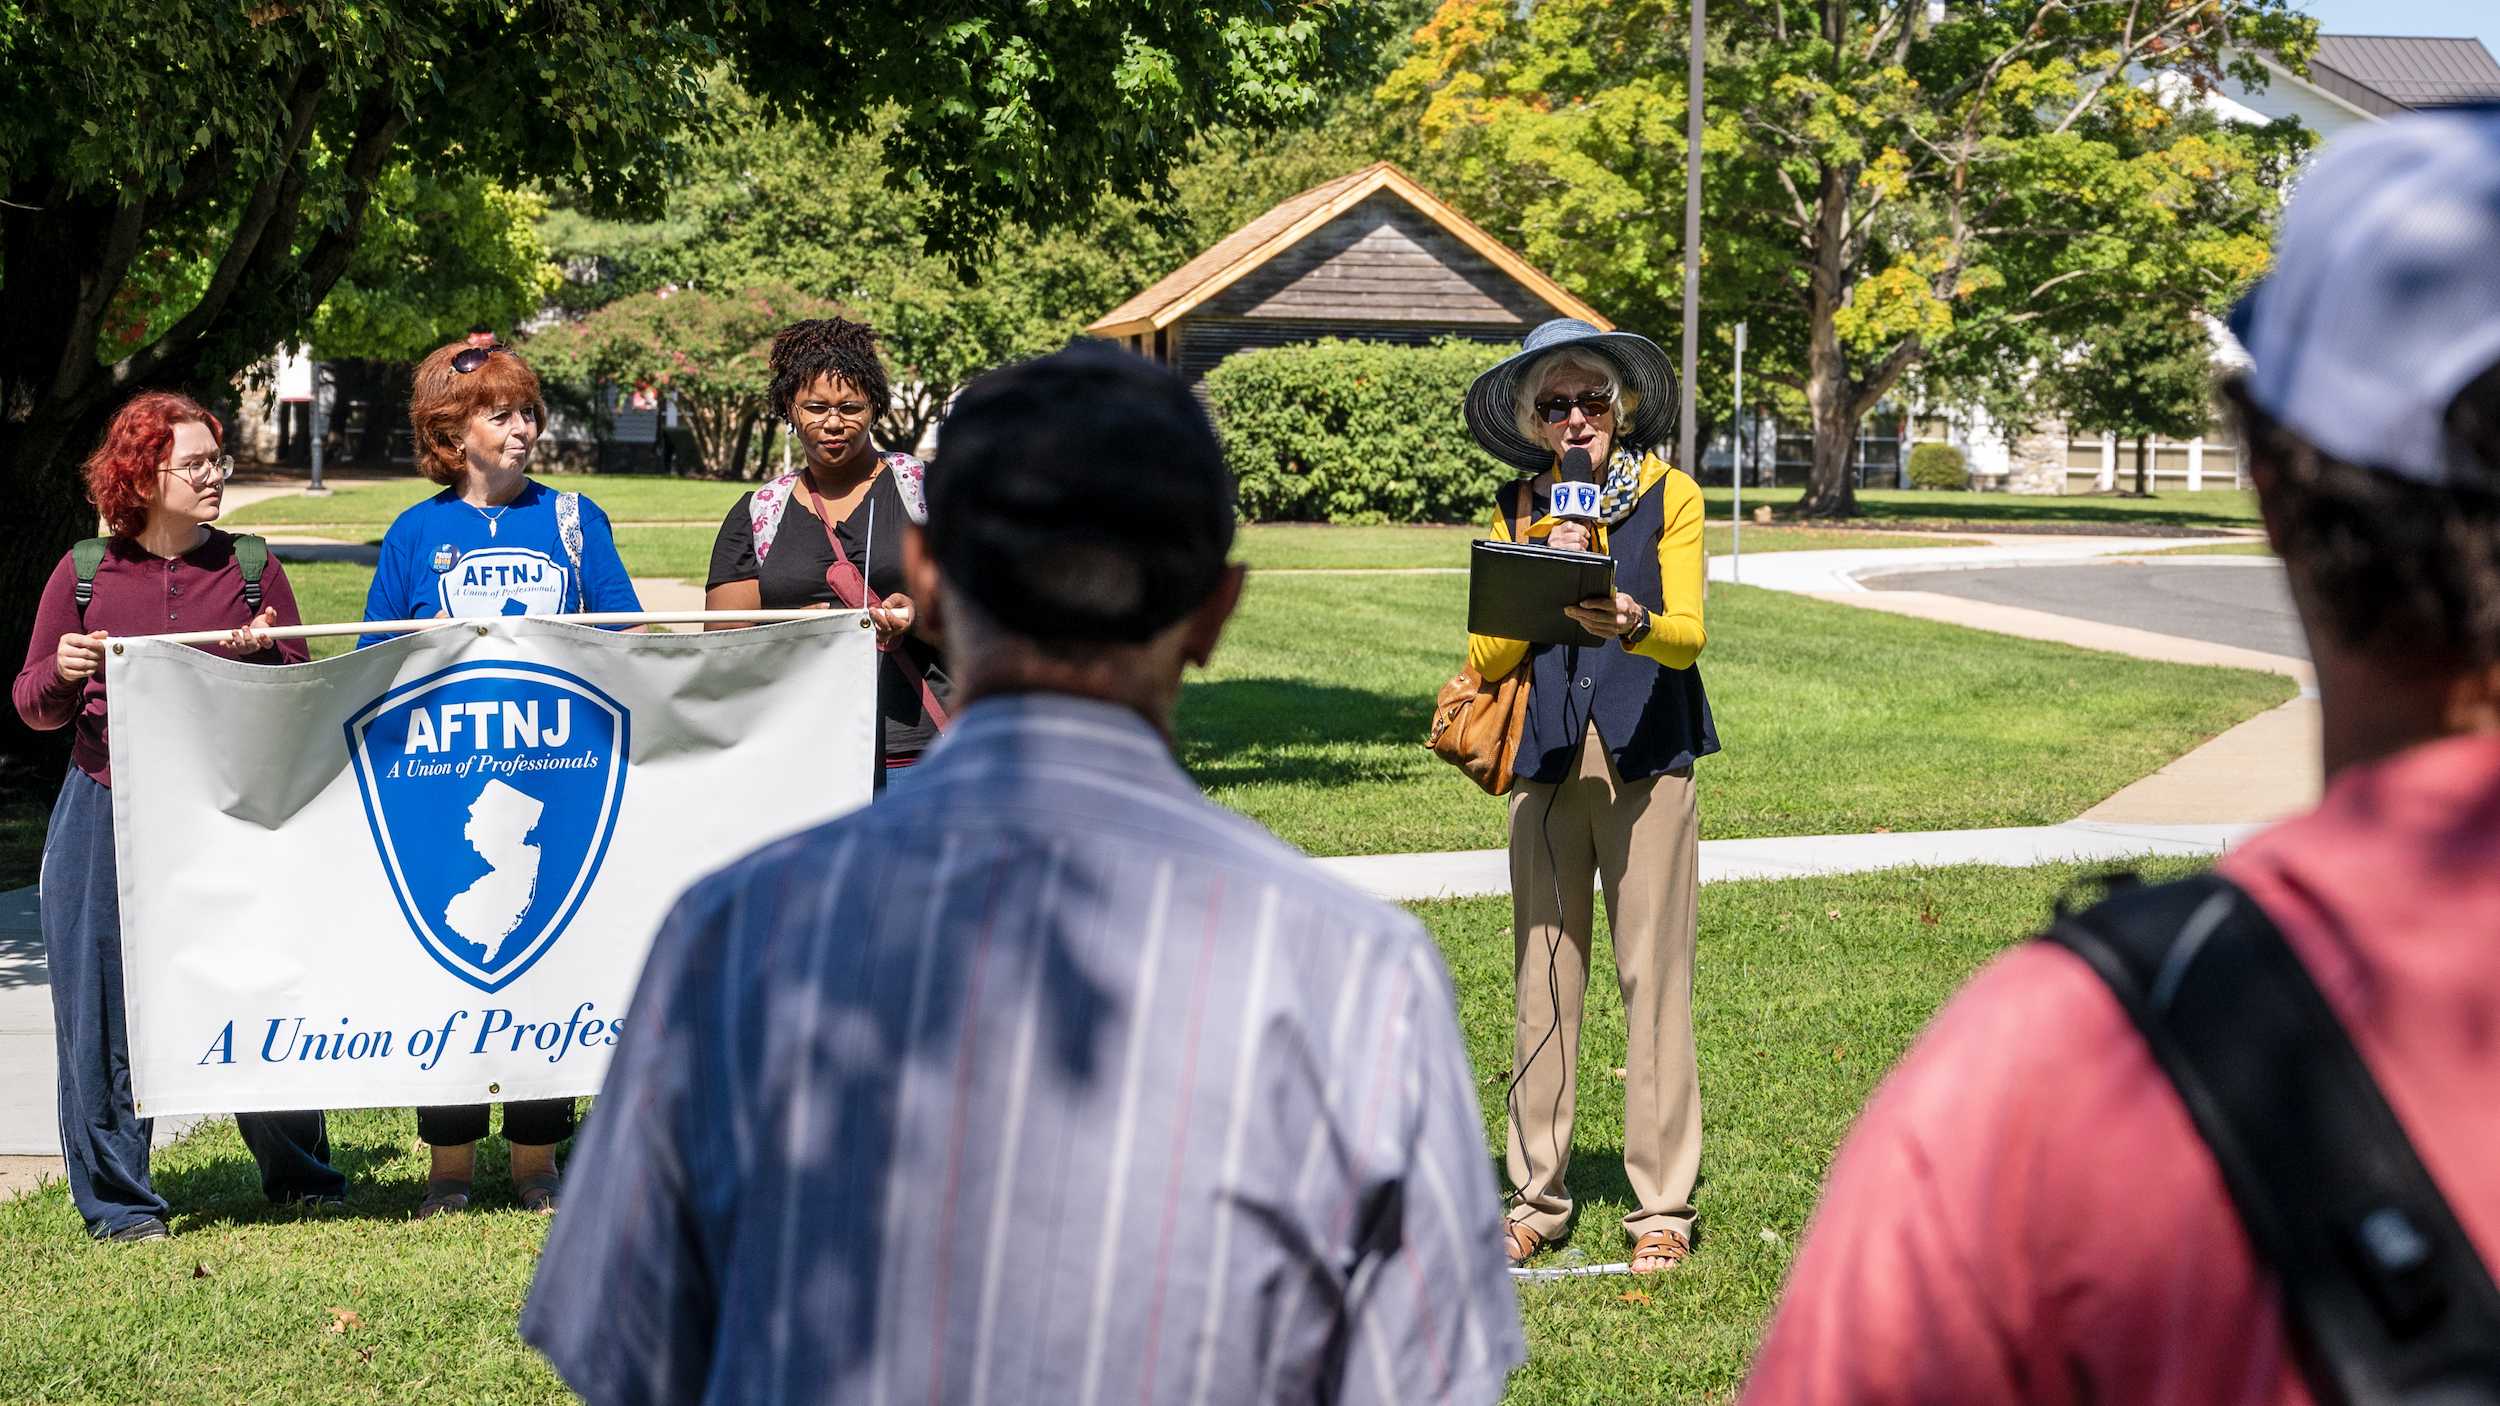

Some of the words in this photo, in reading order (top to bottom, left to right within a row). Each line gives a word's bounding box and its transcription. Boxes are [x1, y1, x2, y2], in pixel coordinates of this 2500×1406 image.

[463, 564, 543, 586] AFTNJ
[453, 588, 460, 596] A
[463, 588, 487, 597] Union
[490, 588, 500, 599] of
[502, 585, 556, 598] Professionals
[404, 699, 570, 754] AFTNJ
[386, 760, 400, 778] A
[406, 758, 452, 777] Union
[455, 755, 477, 778] of
[476, 751, 599, 777] Professionals
[197, 1020, 237, 1066] A
[261, 1017, 394, 1062] Union
[407, 1010, 469, 1071] of
[469, 1002, 627, 1063] Profes
